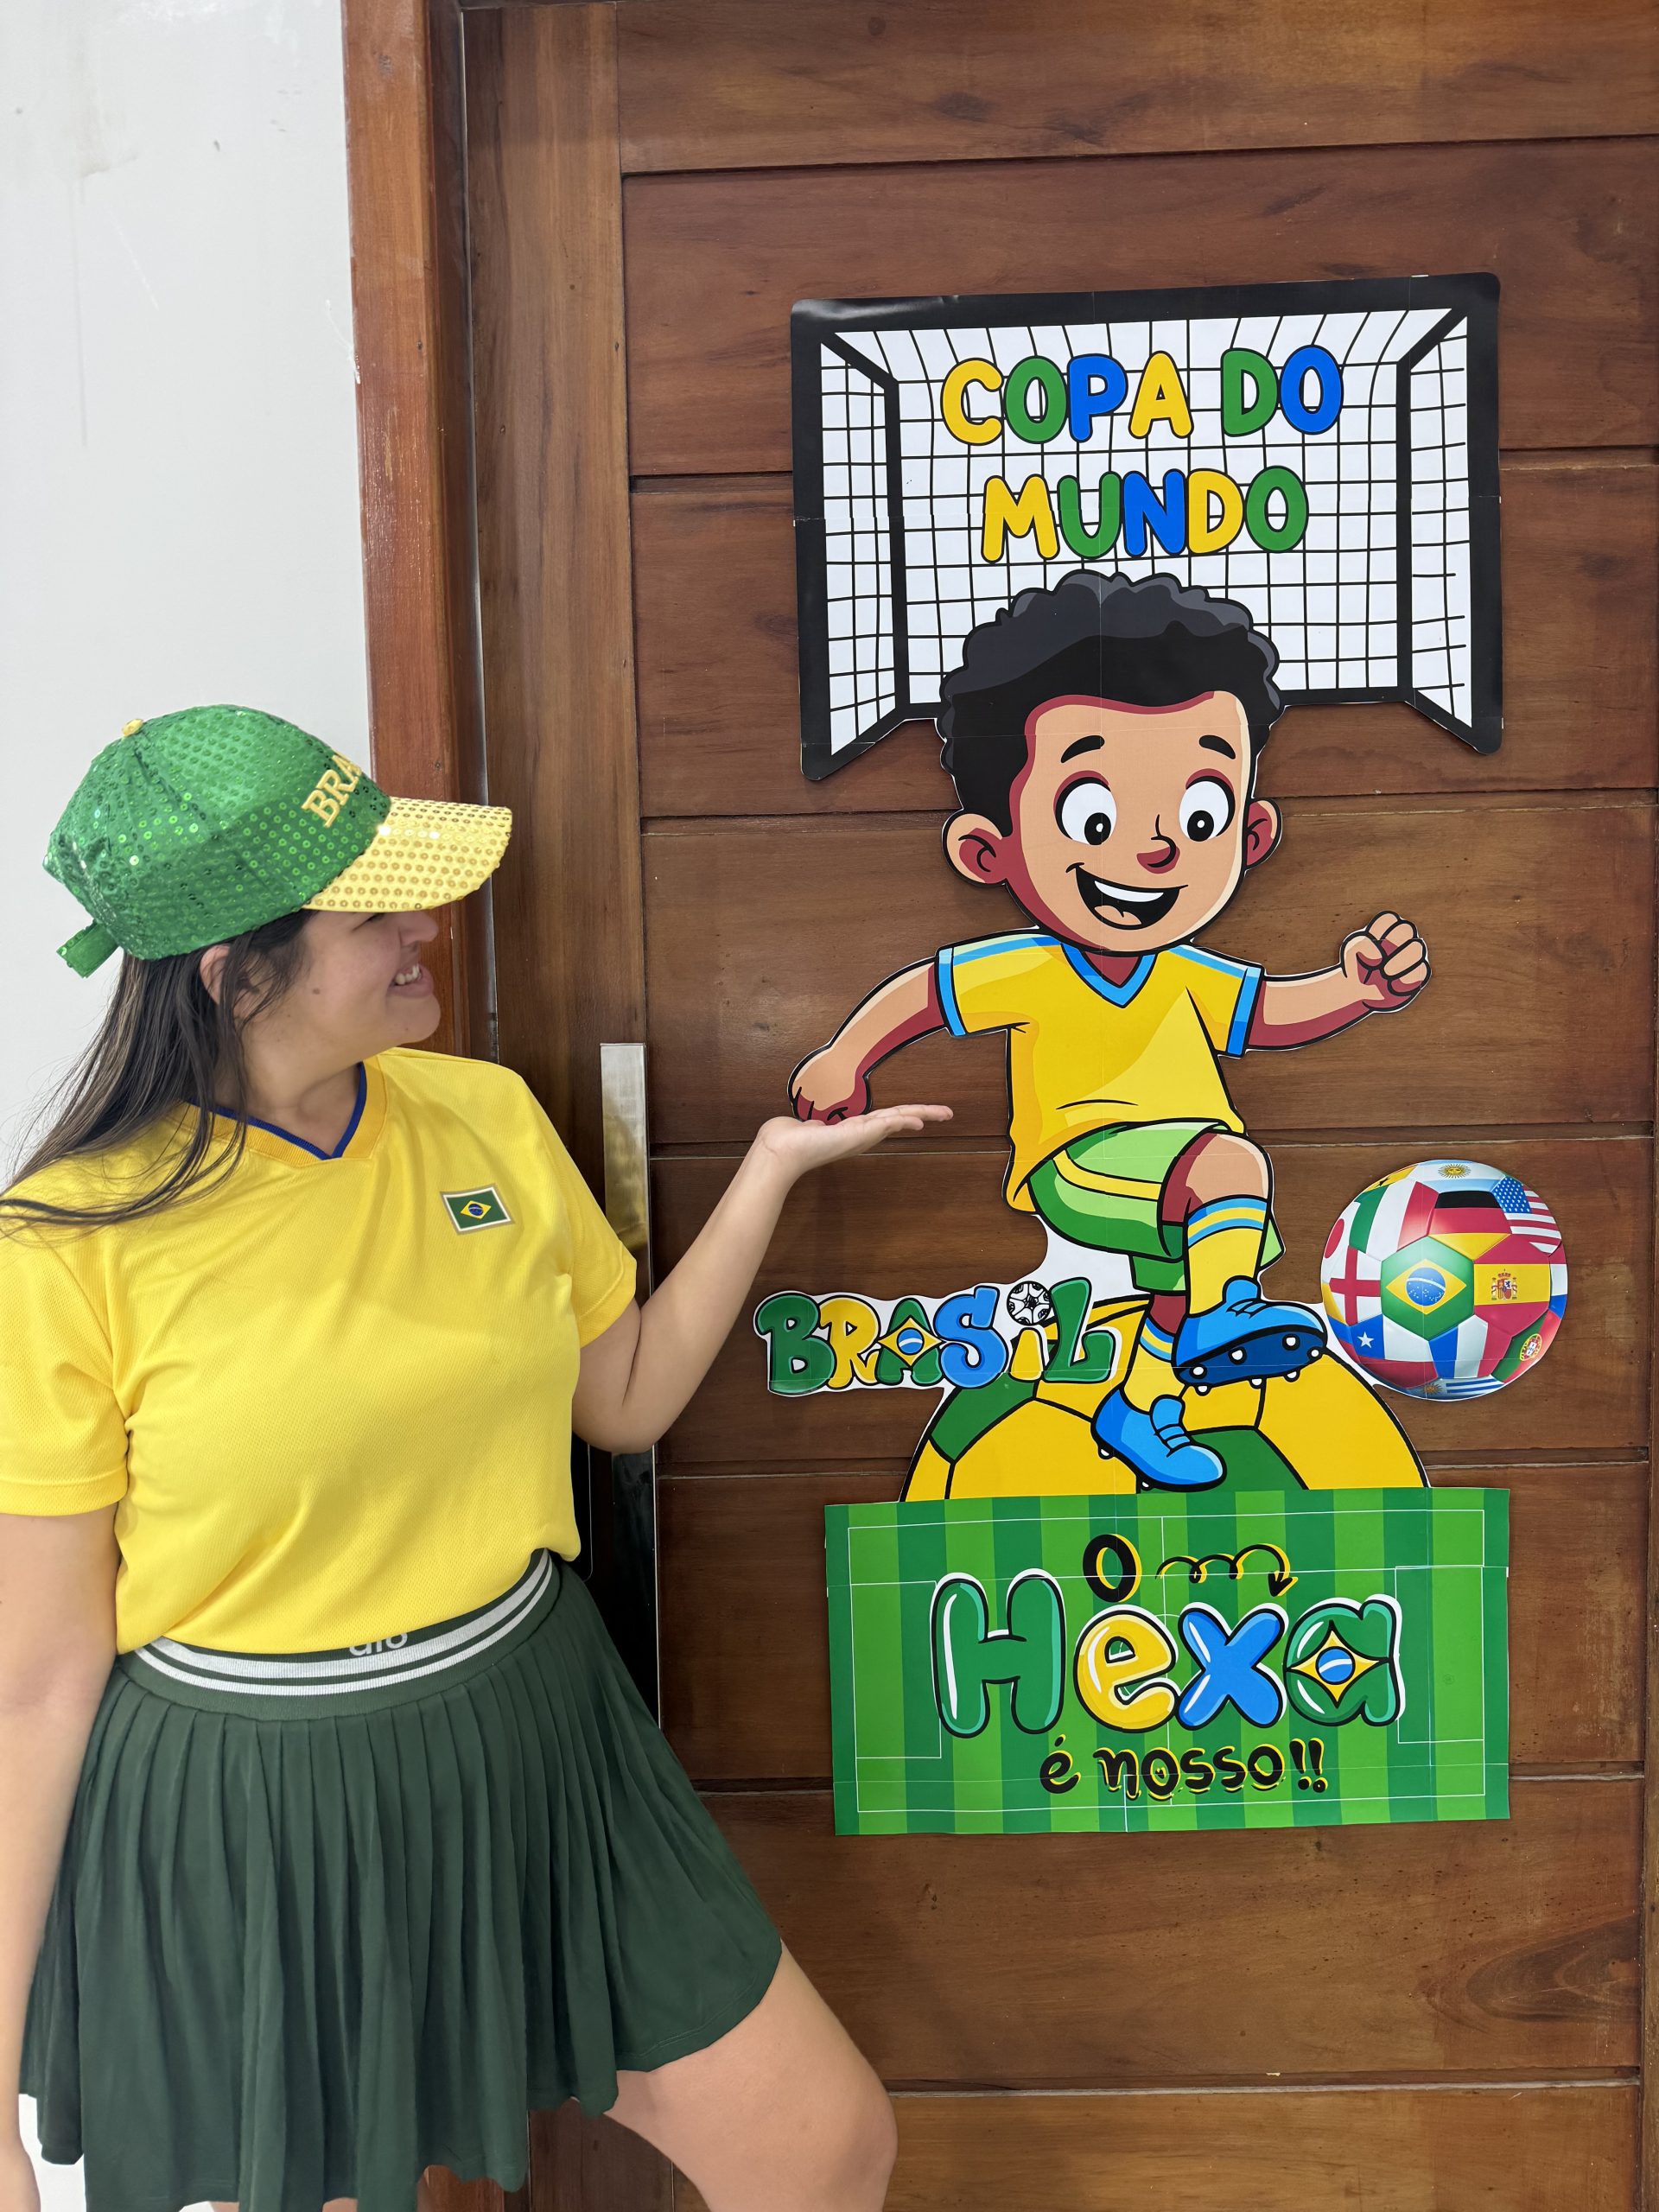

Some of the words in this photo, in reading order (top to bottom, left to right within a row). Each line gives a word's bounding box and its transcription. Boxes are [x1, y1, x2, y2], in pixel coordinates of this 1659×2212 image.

[940, 350, 1194, 446] COPA
[1220, 344, 1344, 437] DO
[981, 465, 1310, 564] MUNDO
[1082, 1533, 1142, 1604] O
[1039, 1733, 1082, 1795] é
[1093, 1737, 1328, 1802] nosso!!
